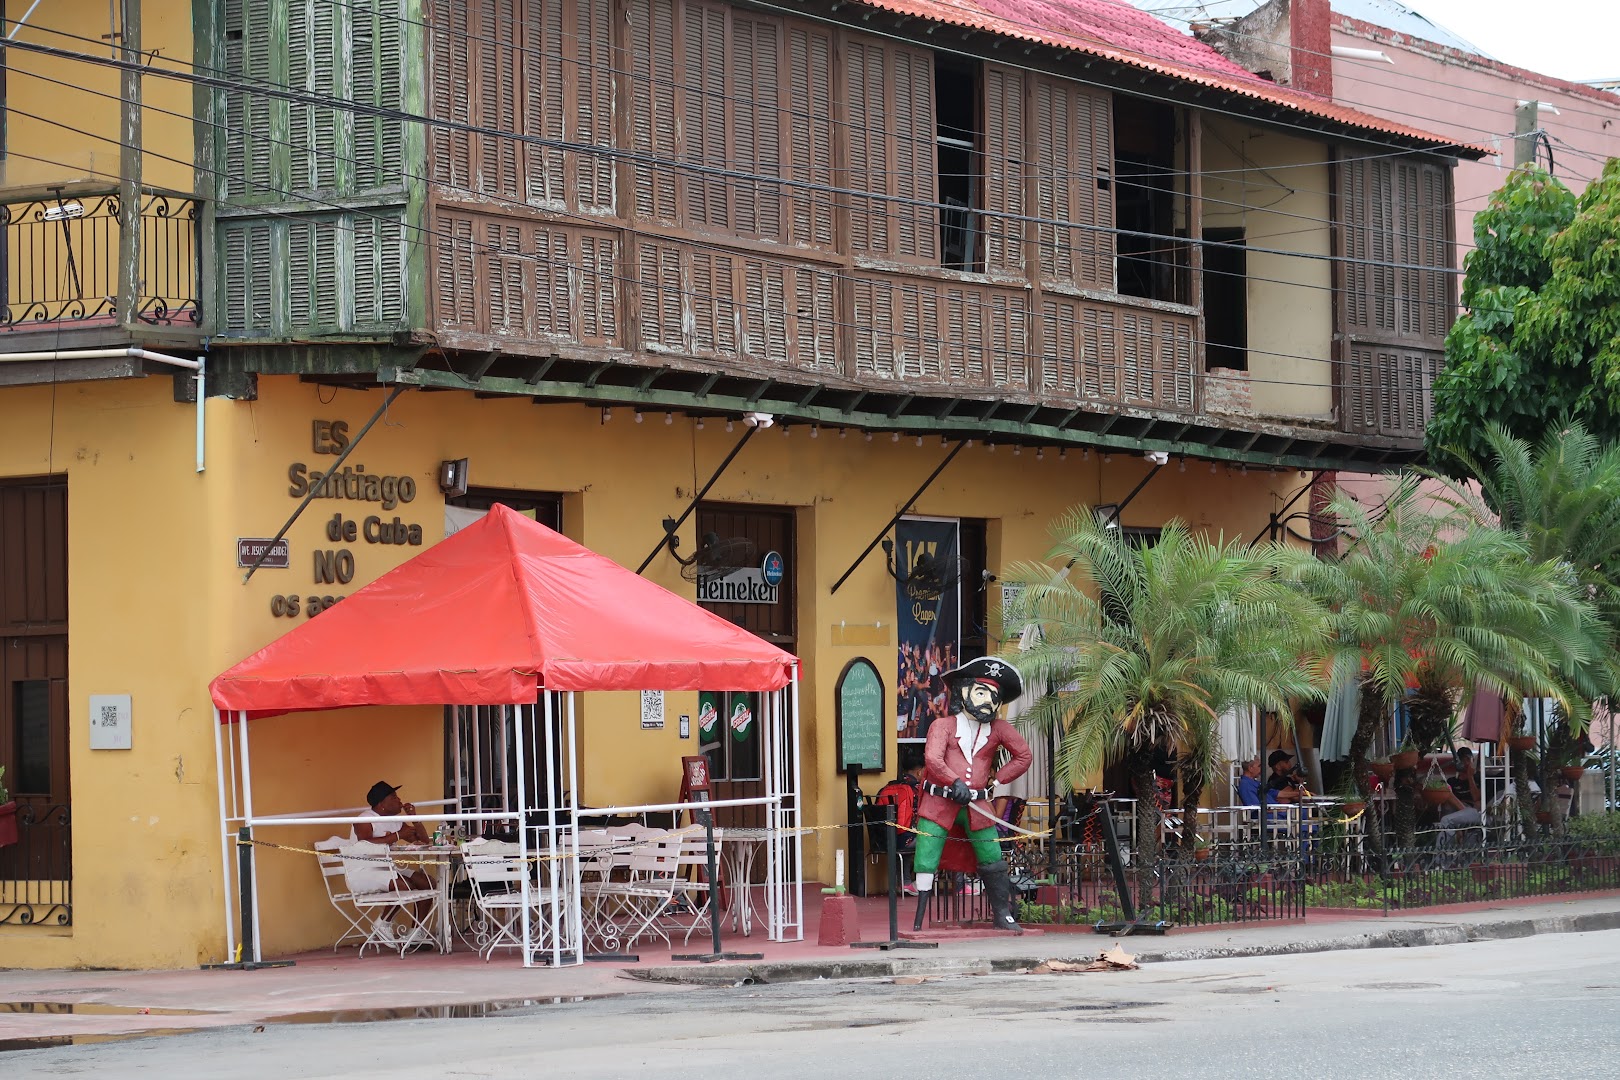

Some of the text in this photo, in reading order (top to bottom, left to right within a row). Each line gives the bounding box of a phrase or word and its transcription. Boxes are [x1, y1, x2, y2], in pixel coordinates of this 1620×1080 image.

[312, 419, 350, 456] ES
[288, 462, 416, 511] Santiago
[327, 512, 423, 545] de Cuba
[314, 548, 355, 584] NO
[696, 574, 777, 602] Heineken
[911, 601, 937, 625] Lager
[700, 710, 716, 728] CRISTAL
[732, 710, 750, 729] CRISTAL
